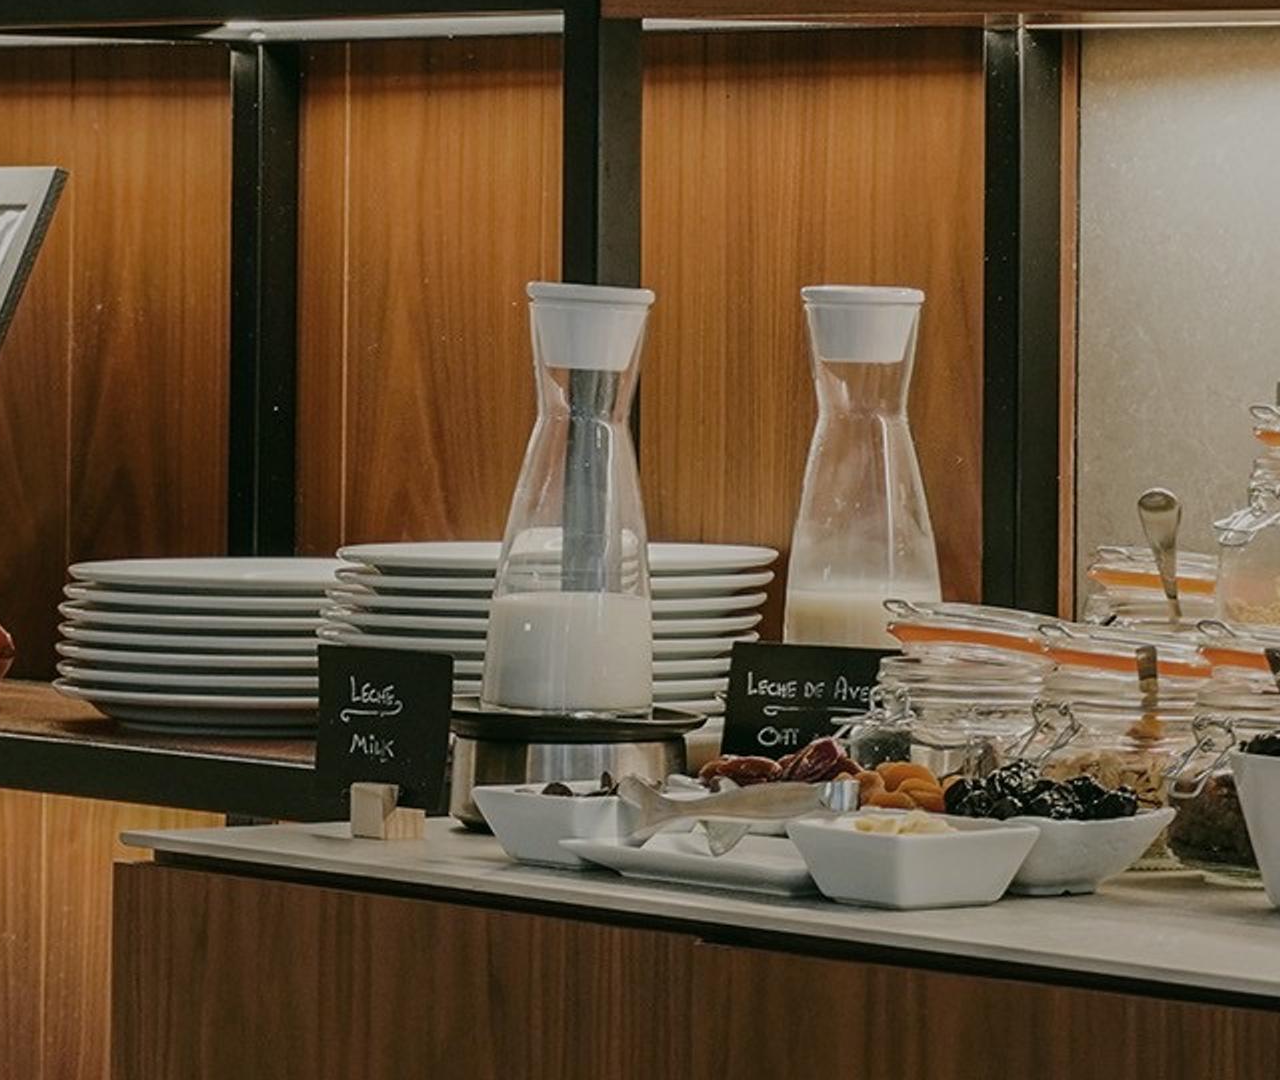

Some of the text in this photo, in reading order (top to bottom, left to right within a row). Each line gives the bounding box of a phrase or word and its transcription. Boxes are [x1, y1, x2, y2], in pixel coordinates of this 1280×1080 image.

[747, 671, 870, 701] LECHE DE AVE
